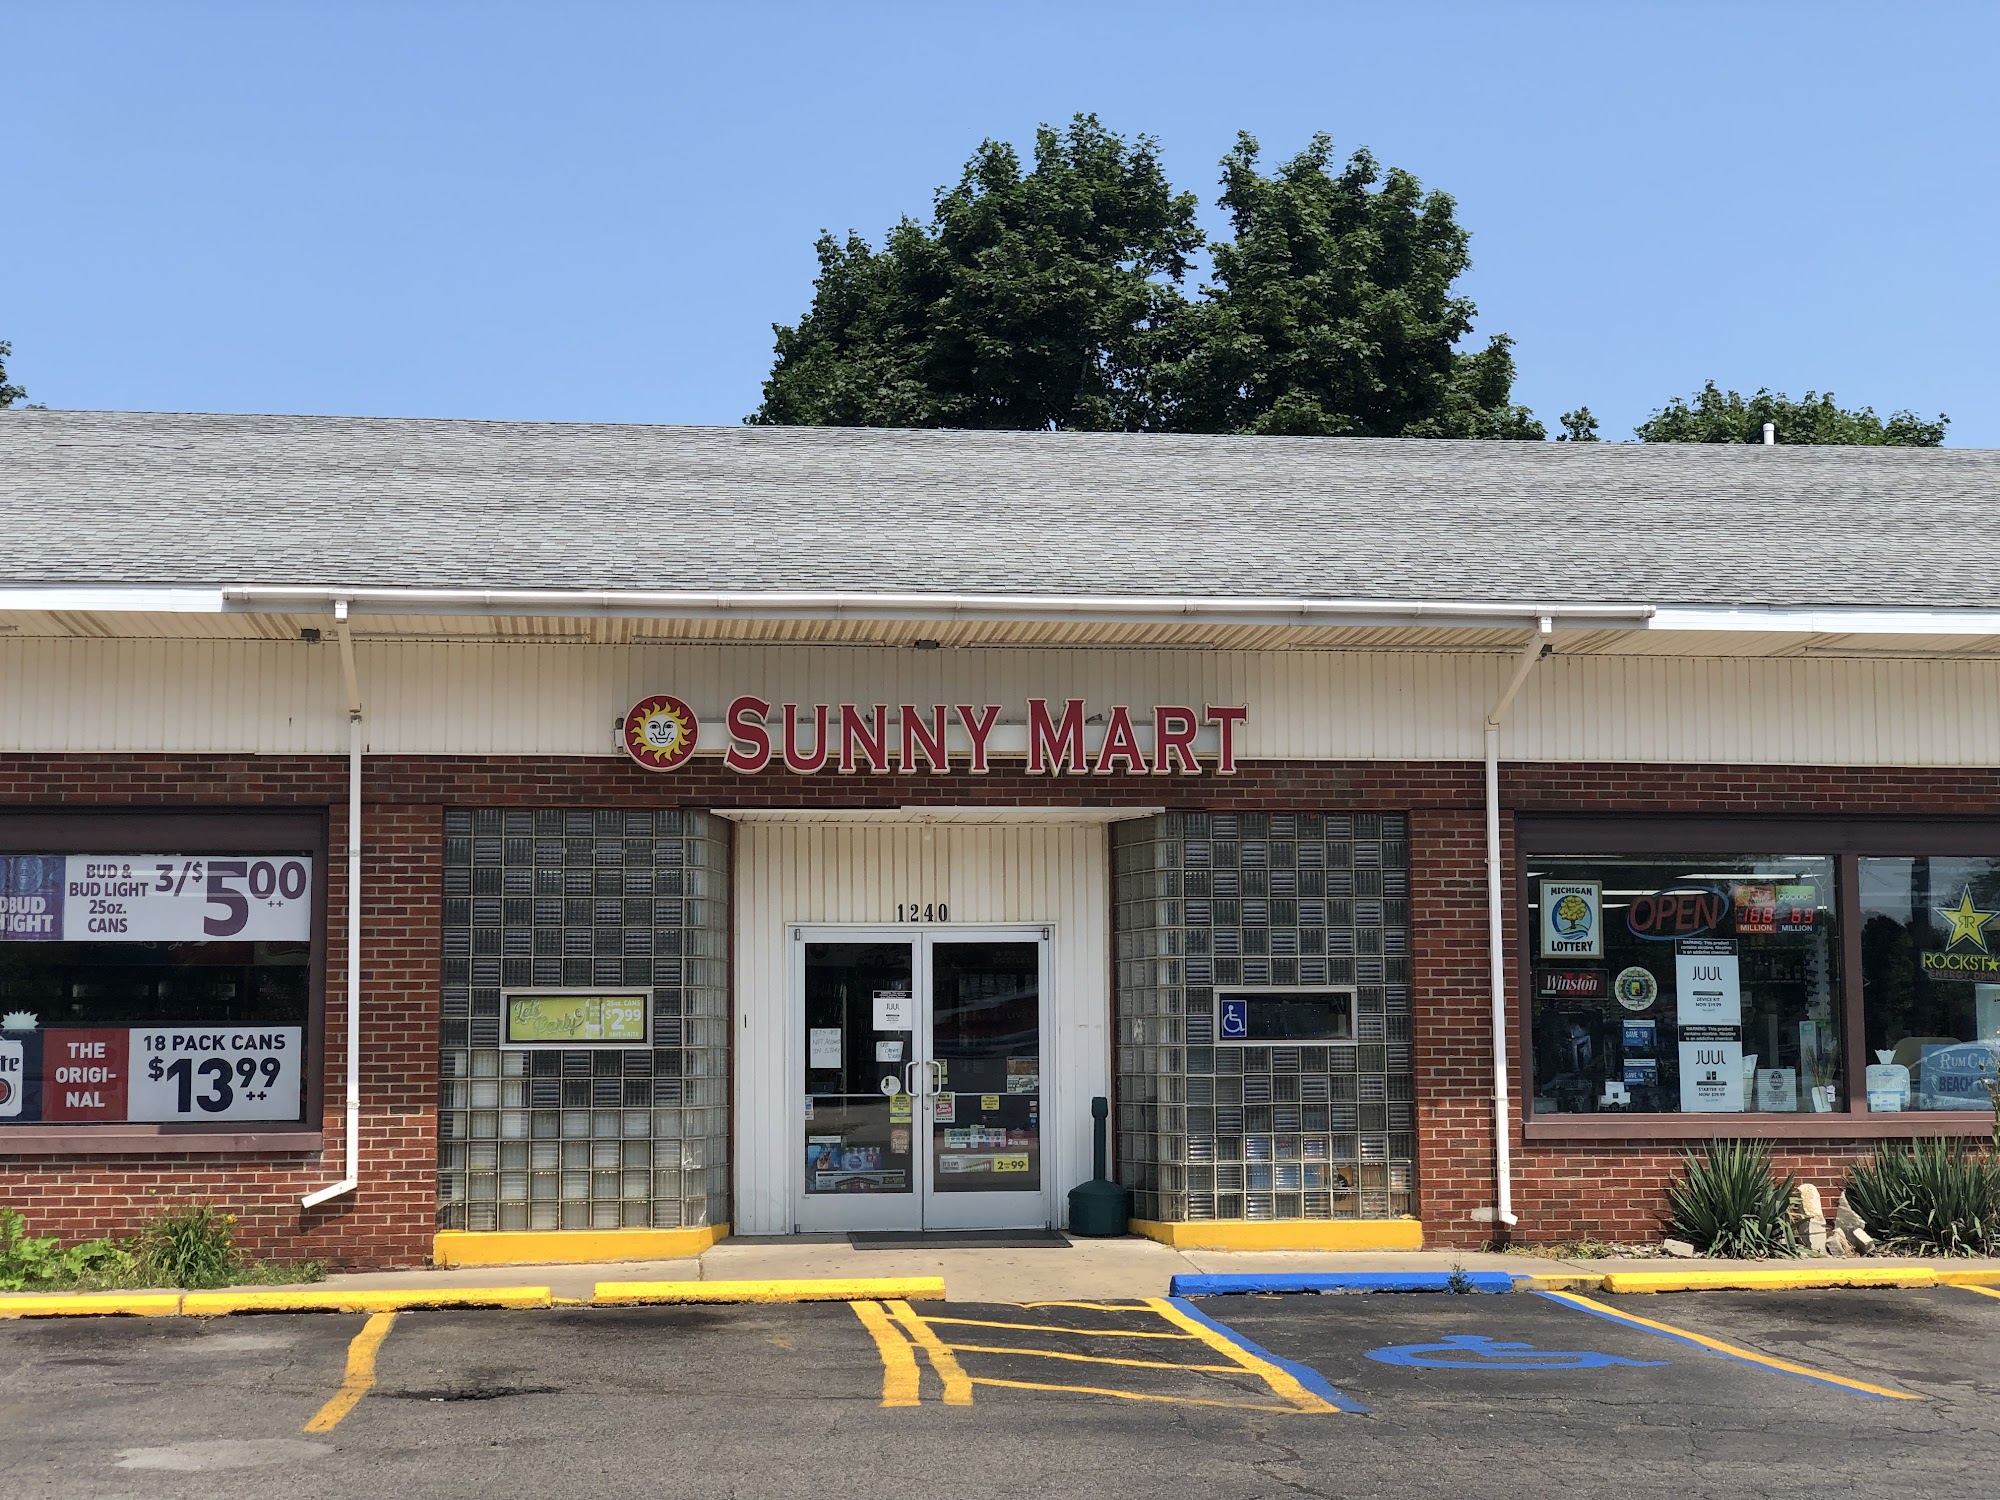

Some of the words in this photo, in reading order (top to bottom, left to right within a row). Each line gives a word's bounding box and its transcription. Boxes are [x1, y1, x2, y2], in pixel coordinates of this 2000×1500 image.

[724, 695, 1003, 775] SUNNY
[1025, 697, 1250, 778] MART
[86, 863, 118, 879] BUD
[121, 863, 132, 879] &
[69, 882, 101, 897] BUD
[104, 882, 149, 897] LIGHT
[1550, 886, 1593, 897] MICHIGAN
[89, 899, 127, 915] 25oz.
[897, 903, 949, 922] 1240
[1629, 894, 1719, 931] OPEN
[87, 917, 128, 933] CANS
[1740, 924, 1773, 932] MILLION
[1781, 924, 1813, 932] MILLION
[1551, 940, 1593, 952] LOTTERY
[1692, 966, 1723, 981] JUUL
[1929, 969, 1969, 980] ENERGY
[1546, 974, 1598, 991] Winston
[67, 1042, 106, 1059] THE
[143, 1035, 166, 1051] 18
[173, 1034, 226, 1051] PACK
[232, 1034, 286, 1050] CANS
[1695, 1050, 1726, 1065] JUUL
[55, 1067, 117, 1084] ORIGI-
[65, 1091, 106, 1108] NAL
